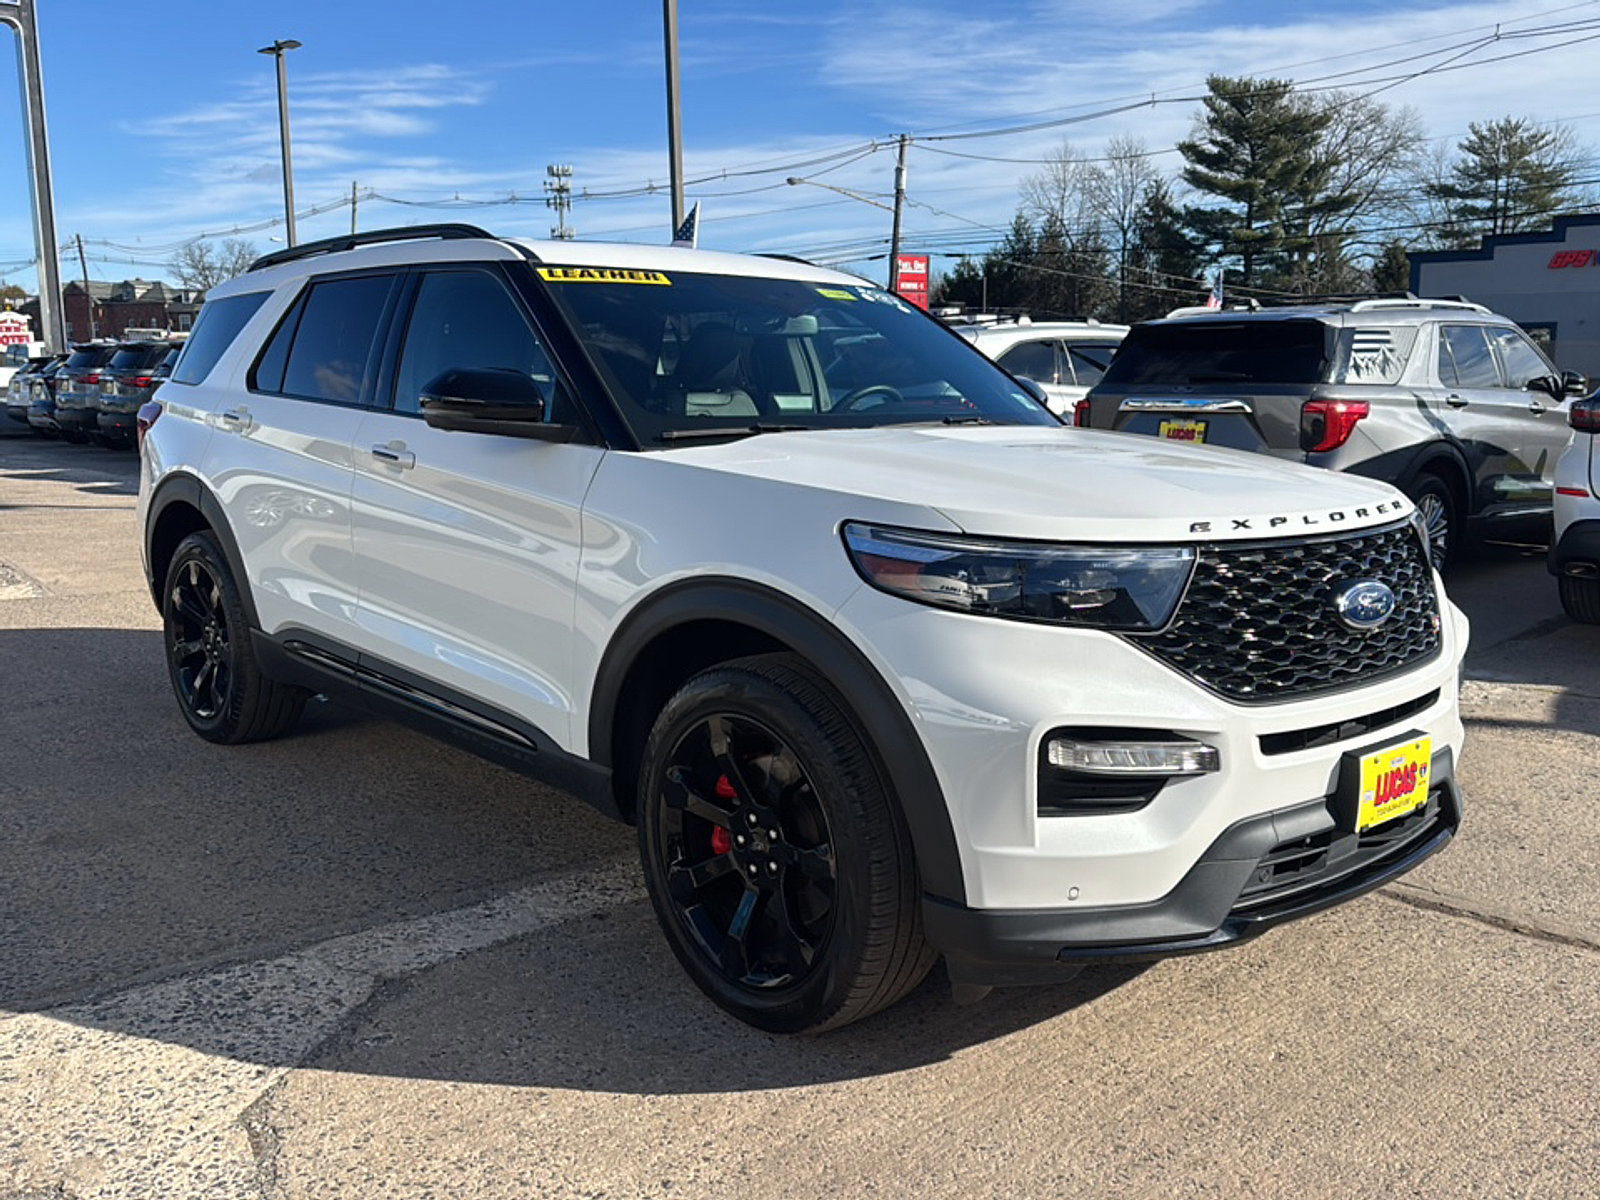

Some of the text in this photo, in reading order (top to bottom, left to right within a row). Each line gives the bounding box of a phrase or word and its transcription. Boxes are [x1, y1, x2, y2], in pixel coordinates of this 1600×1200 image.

[547, 268, 664, 282] LEATHER
[1167, 427, 1196, 441] LUCAS
[1189, 499, 1403, 533] EXPLORER
[1374, 761, 1418, 807] LUCAS
